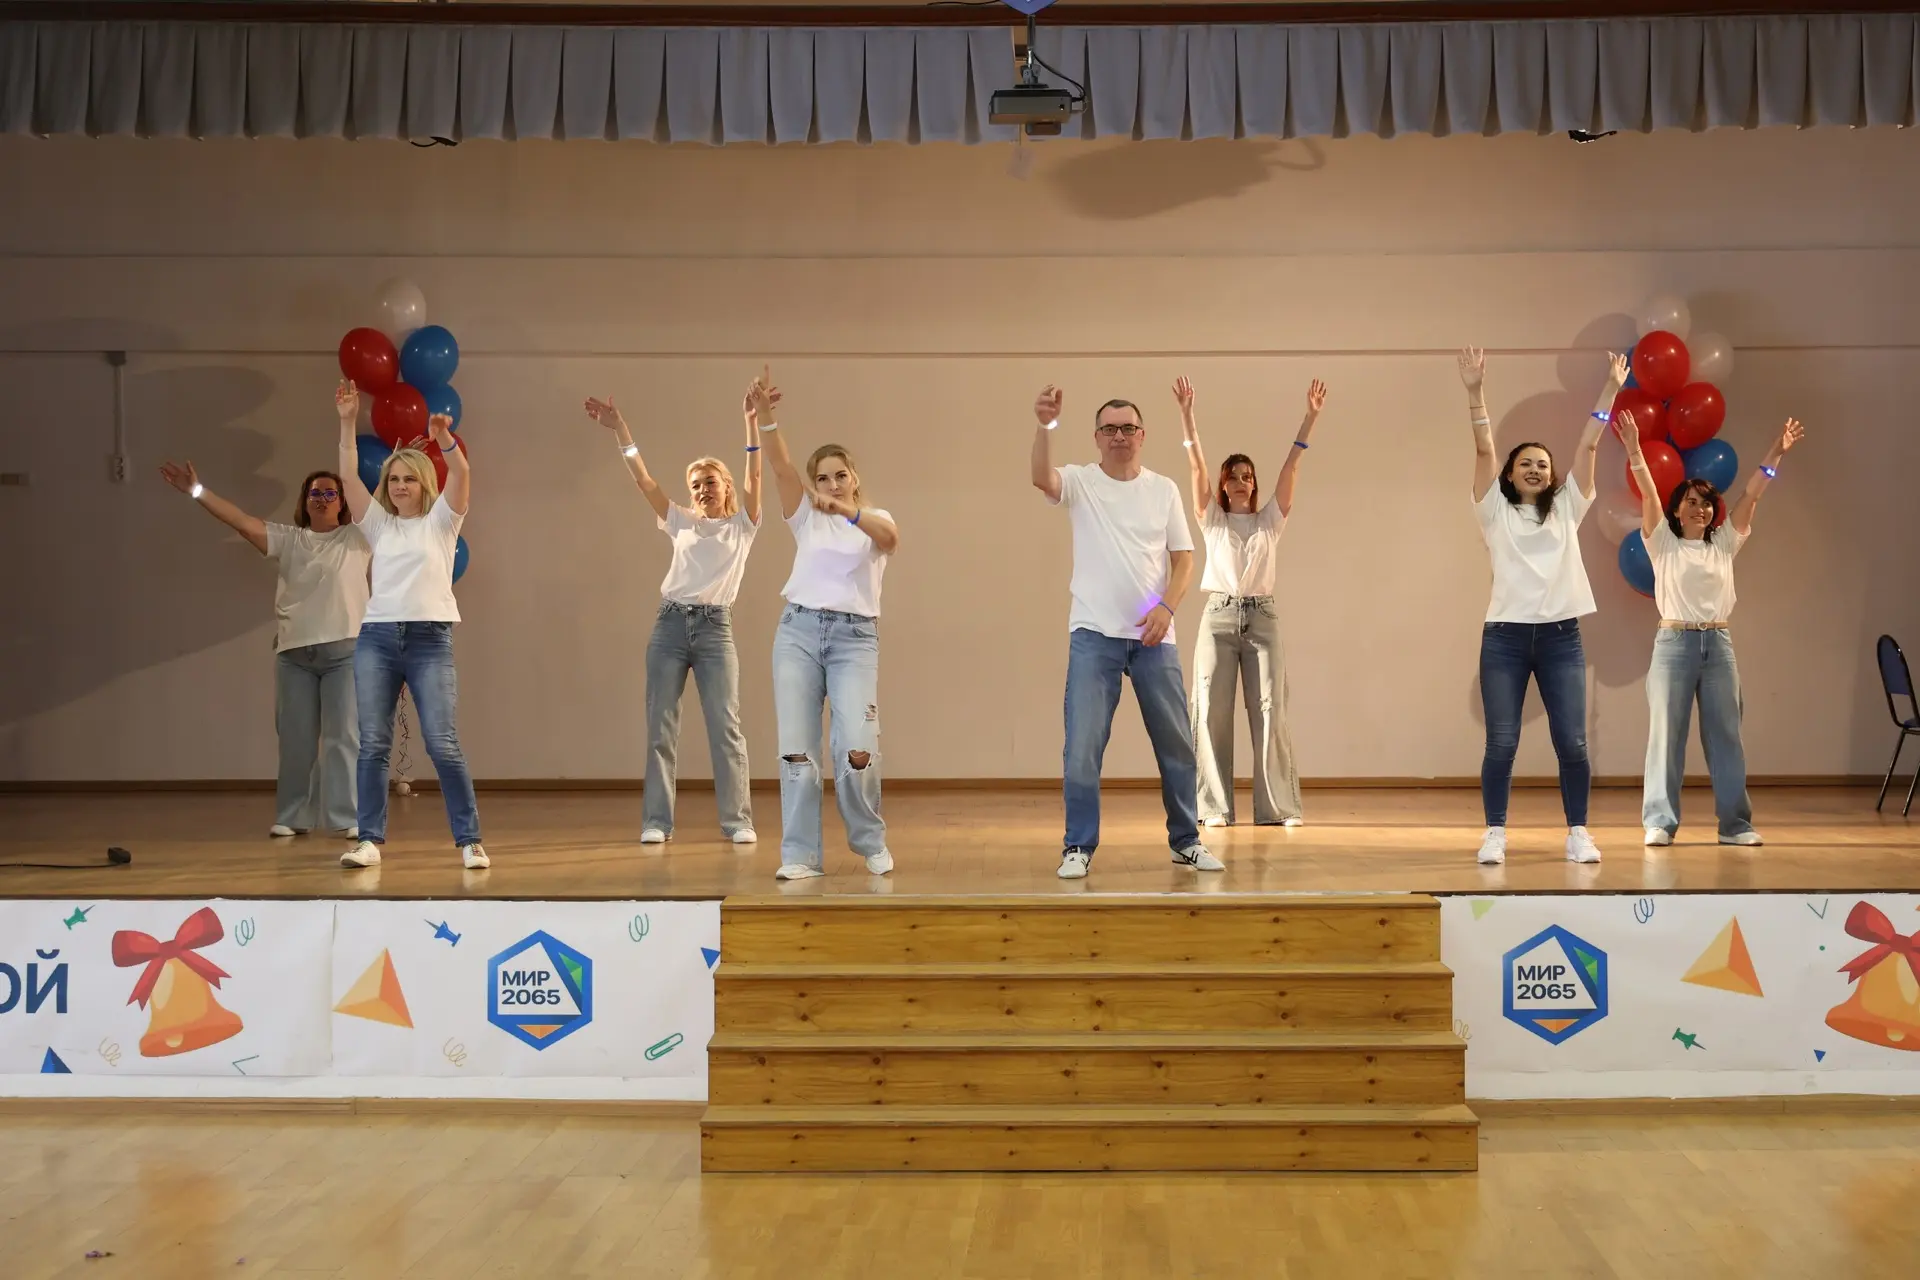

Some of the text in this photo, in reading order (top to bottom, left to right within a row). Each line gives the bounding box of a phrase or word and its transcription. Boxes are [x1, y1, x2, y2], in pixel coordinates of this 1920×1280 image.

[502, 970, 550, 986] МИР
[1517, 965, 1566, 982] МИР
[501, 989, 561, 1005] 2065
[1516, 984, 1577, 1000] 2065
